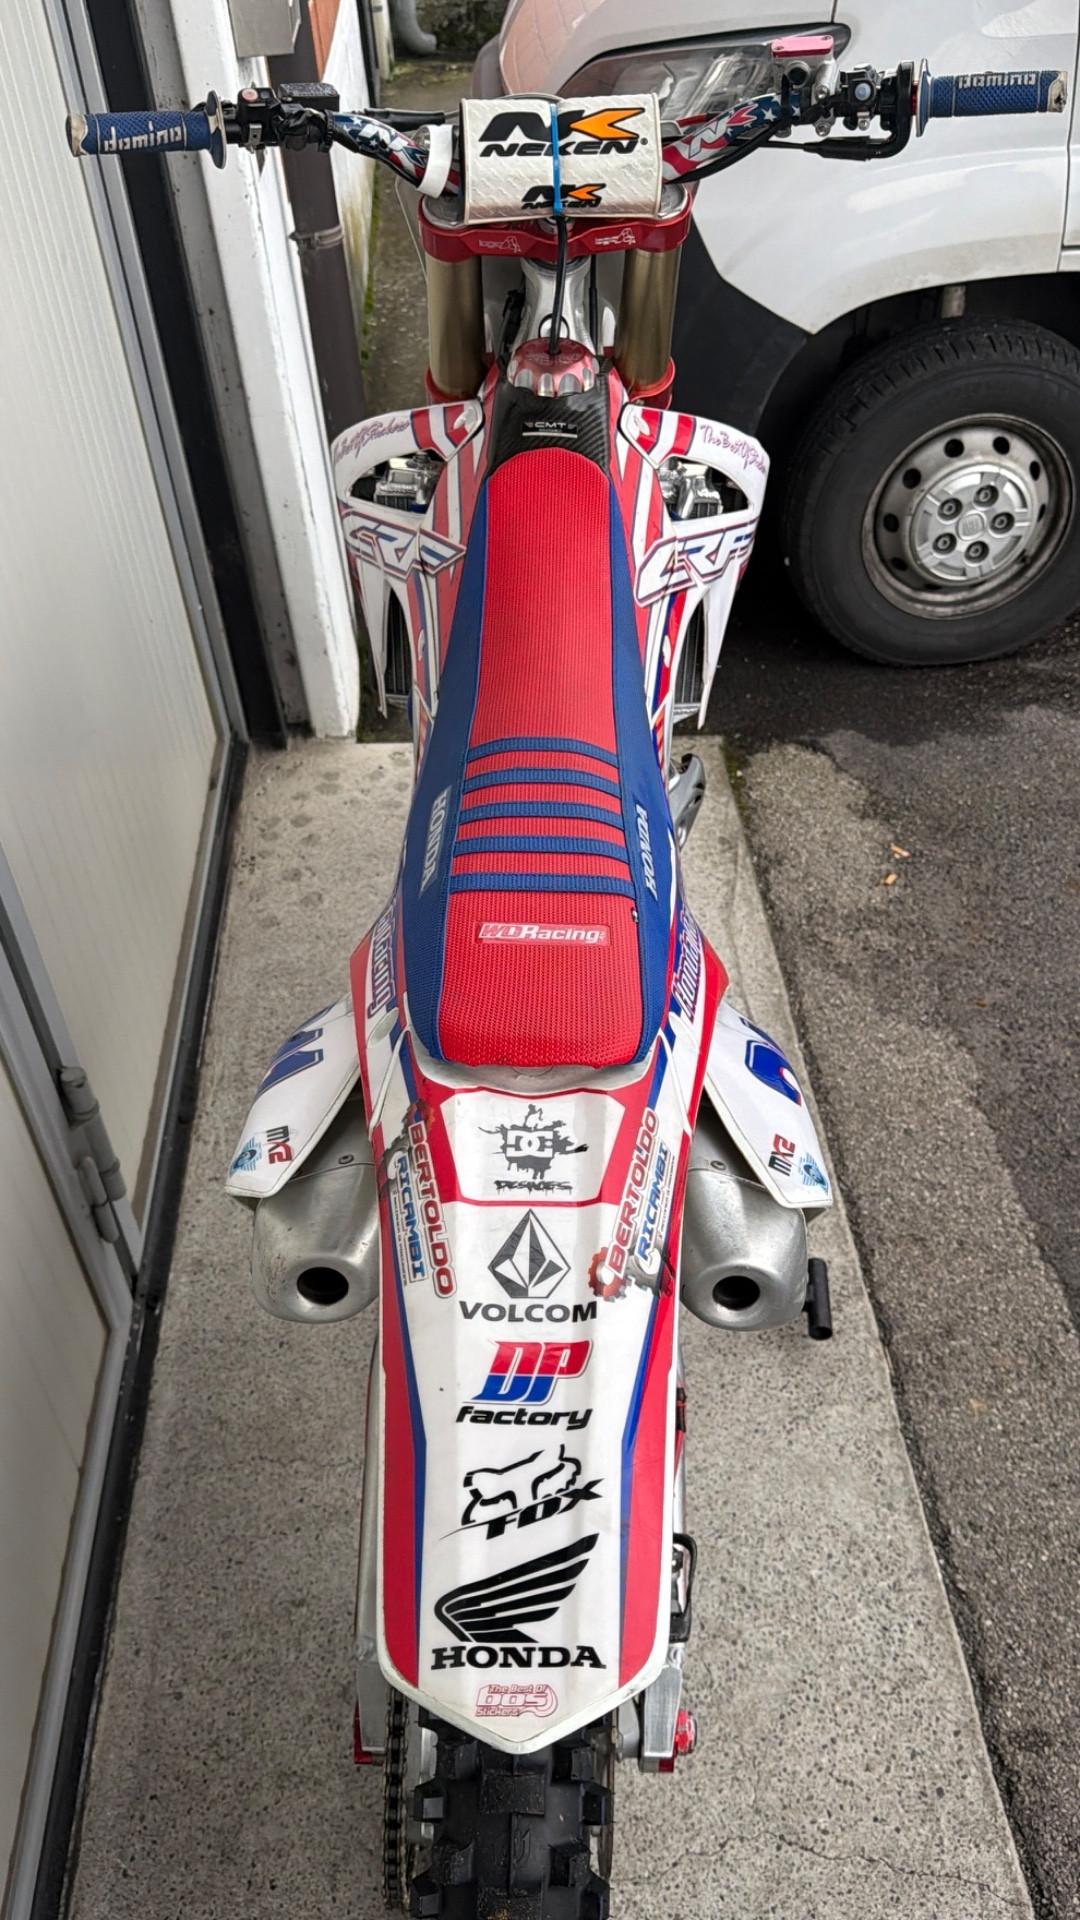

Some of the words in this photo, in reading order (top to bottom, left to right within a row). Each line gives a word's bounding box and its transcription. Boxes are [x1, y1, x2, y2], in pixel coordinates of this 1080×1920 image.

[104, 120, 182, 151] domino
[534, 421, 567, 429] CMT
[634, 517, 758, 605] CRF
[420, 788, 447, 892] HONDA
[635, 803, 658, 901] HONDA
[265, 1125, 293, 1165] MX2
[767, 1133, 796, 1177] MX2
[397, 1154, 426, 1279] RICAMBI
[409, 1122, 454, 1297] BERTOLDO
[606, 1107, 657, 1275] BERTOLDO
[636, 1142, 669, 1261] RICAMBI
[459, 1300, 598, 1323] VOLCOM
[455, 1405, 593, 1431] factory
[482, 1478, 605, 1540] FOX
[431, 1645, 607, 1670] HONDA
[488, 1684, 508, 1694] The
